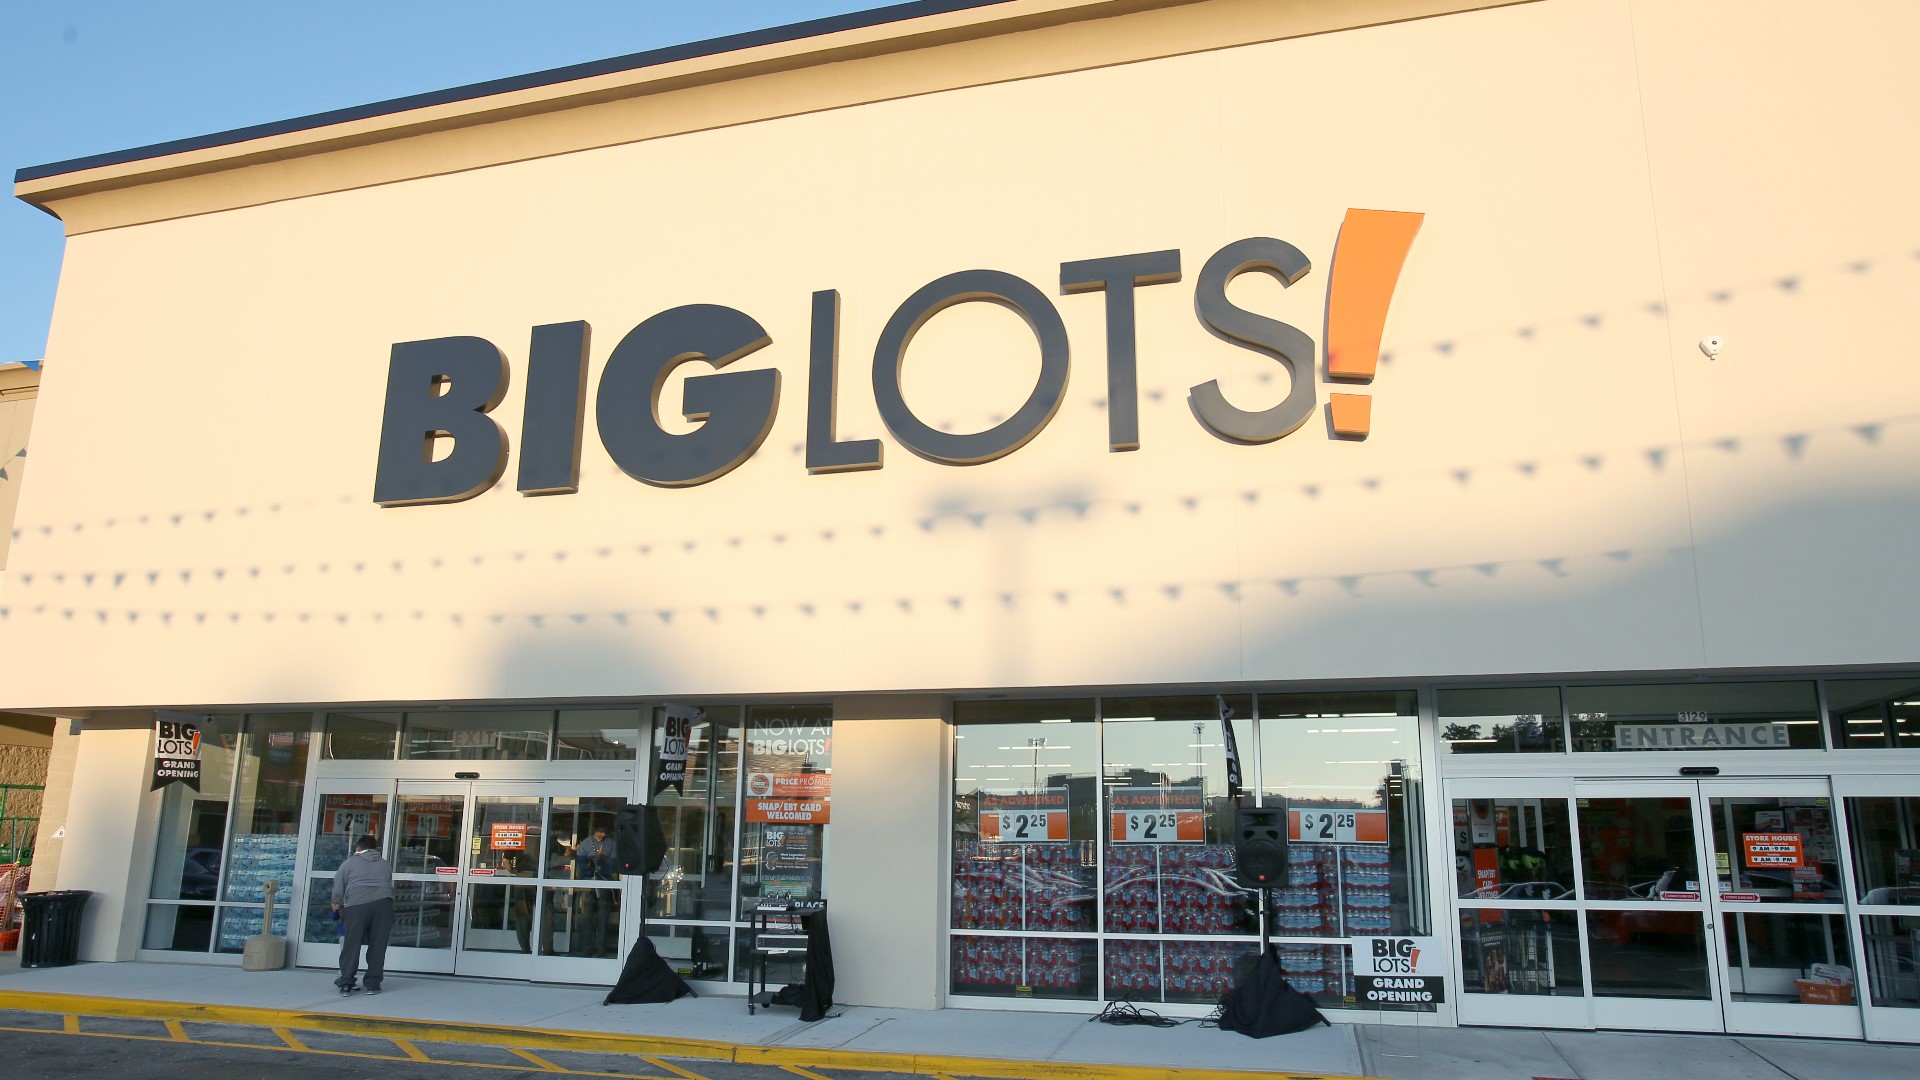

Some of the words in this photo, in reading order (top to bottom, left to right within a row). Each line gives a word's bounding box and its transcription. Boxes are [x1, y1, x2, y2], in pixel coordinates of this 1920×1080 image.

[1679, 711, 1707, 722] 3129
[160, 721, 196, 740] BIG
[666, 716, 690, 738] BIG
[753, 718, 807, 736] NOW
[454, 730, 496, 746] EXIT
[1620, 725, 1787, 746] ENTRANCE
[158, 731, 202, 755] LOTS!
[163, 760, 196, 769] GRAND
[157, 769, 199, 778] OPENING
[799, 777, 831, 786] PROMISE
[983, 796, 998, 806] AS
[1001, 795, 1065, 806] ADVERTISED
[1114, 795, 1129, 806] AS
[757, 802, 798, 811] SNAP/EBT
[800, 803, 822, 812] CARD
[766, 811, 812, 820] WELCOMED
[766, 831, 784, 840] BIG
[1372, 938, 1416, 957] BIG
[1373, 948, 1421, 973] LOTS!
[1372, 977, 1425, 989] GRAND
[1366, 990, 1433, 1002] OPENING
